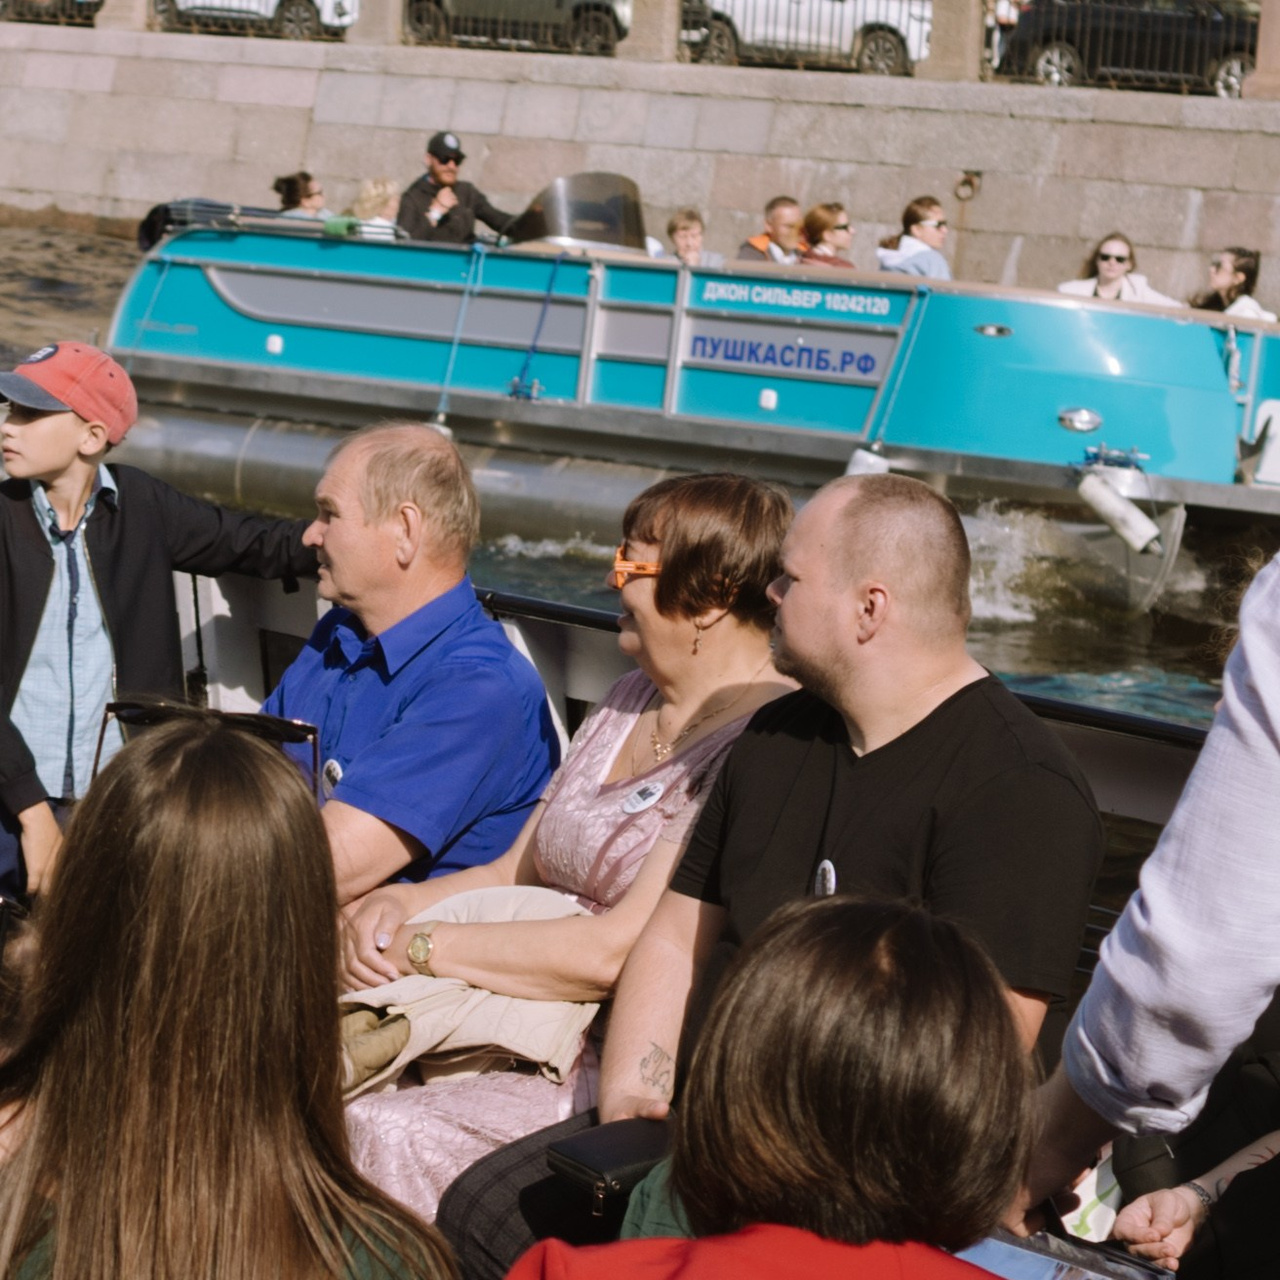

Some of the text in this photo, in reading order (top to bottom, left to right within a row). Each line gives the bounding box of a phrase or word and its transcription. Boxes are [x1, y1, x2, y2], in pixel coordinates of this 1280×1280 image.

[703, 281, 890, 315] ДЖОН СИЛЬВЕР 10242120
[691, 335, 876, 375] ПУШКАСПБ.РФ
